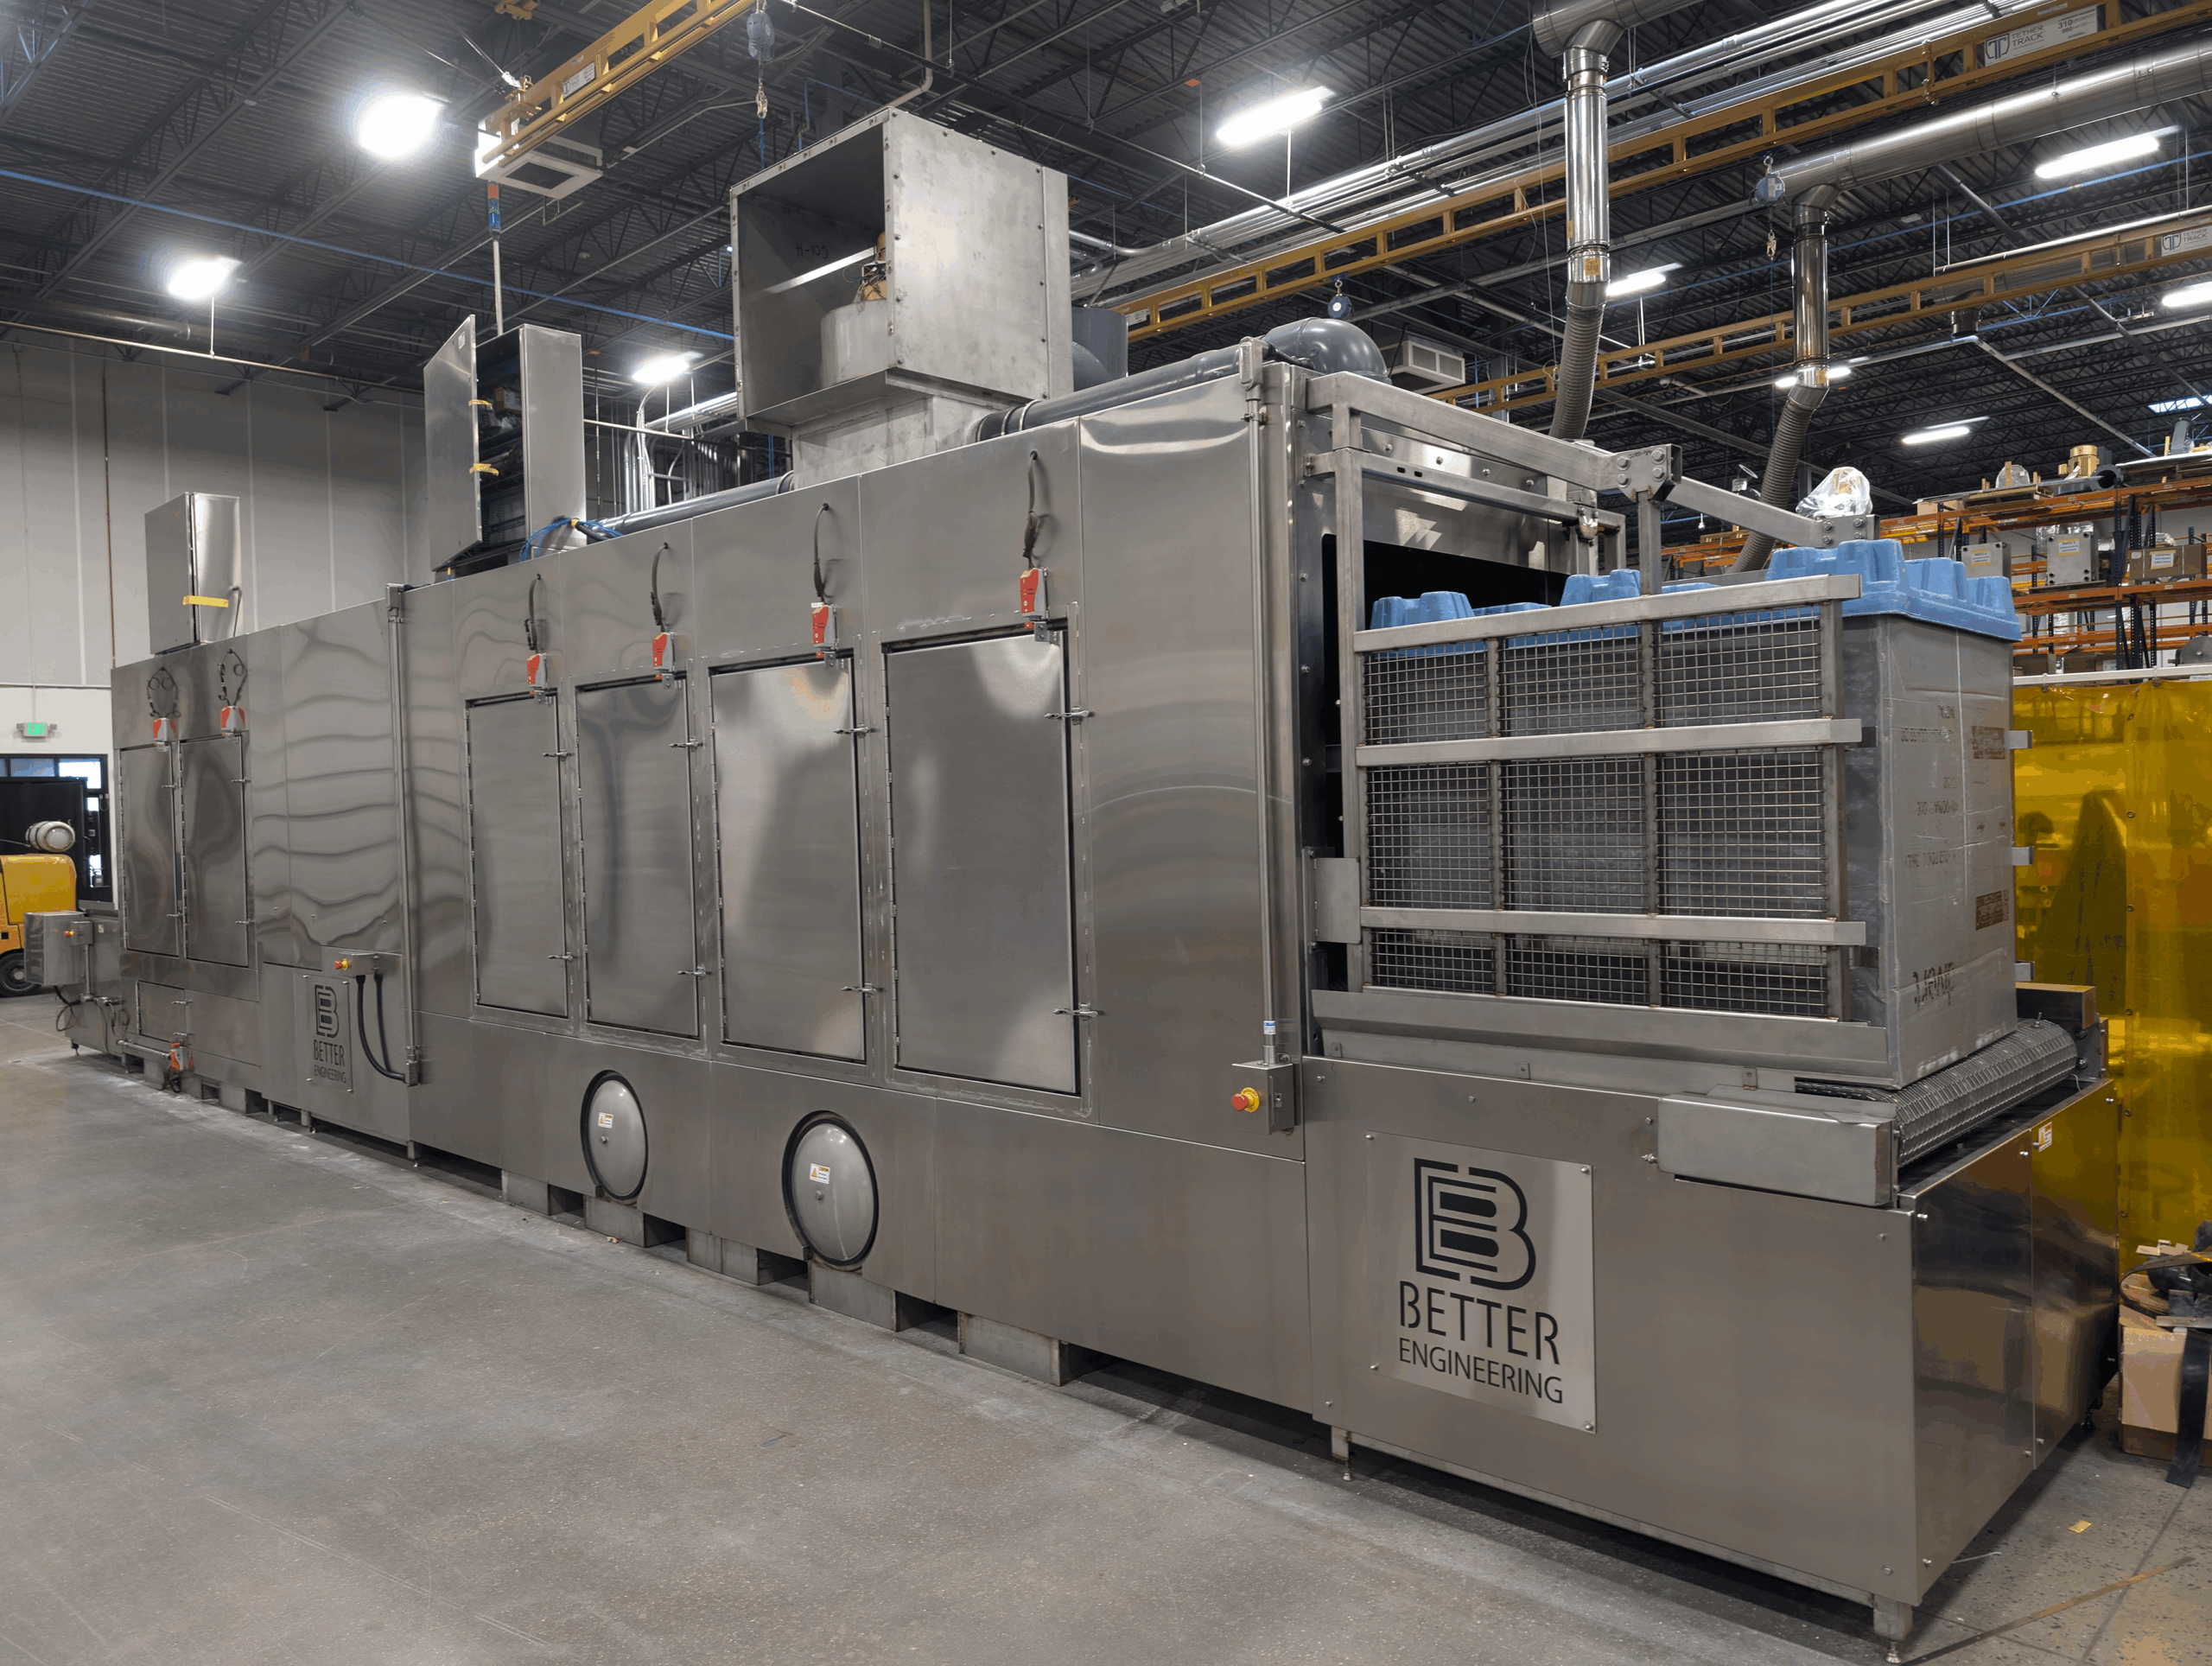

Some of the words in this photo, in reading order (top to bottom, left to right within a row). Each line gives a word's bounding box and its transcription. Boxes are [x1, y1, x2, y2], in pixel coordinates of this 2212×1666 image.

[2012, 24, 2044, 39] TETHER
[2012, 32, 2044, 47] TRACK
[2183, 227, 2208, 238] TETHER
[2183, 232, 2208, 243] TRACK
[313, 1040, 346, 1067] BETTER
[314, 1065, 346, 1084] ENGINEERING
[1399, 1281, 1560, 1365] BETTER
[1399, 1337, 1563, 1404] ENGINEERING
